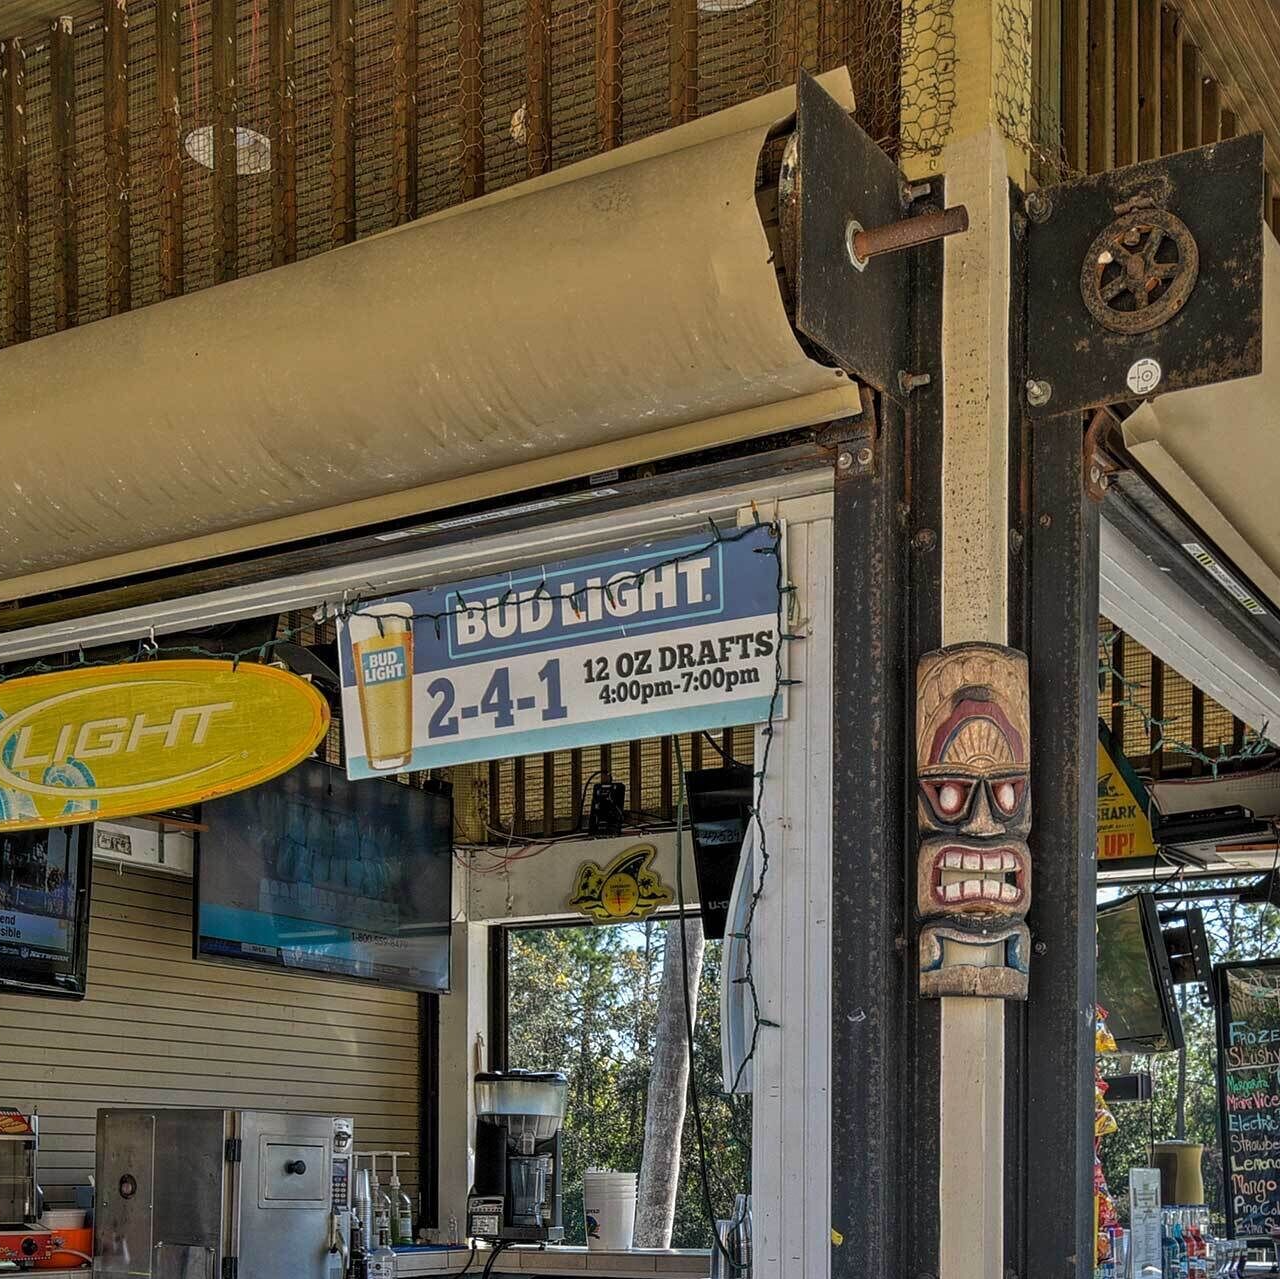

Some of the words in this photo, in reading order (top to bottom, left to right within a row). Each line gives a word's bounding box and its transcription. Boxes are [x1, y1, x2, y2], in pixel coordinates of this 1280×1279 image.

[457, 581, 553, 646] BUD
[560, 557, 711, 626] LIGHT
[365, 663, 403, 682] LIGHT
[369, 651, 397, 668] BUD
[583, 656, 609, 683] 12
[616, 649, 652, 678] OZ
[658, 630, 774, 672] DRAFTS
[427, 658, 568, 739] 2-4-1
[599, 667, 760, 704] 4:00pm-7:00pm
[9, 701, 233, 767] LIGHT
[1104, 832, 1135, 857] UP!
[1253, 1091, 1280, 1109] Vice
[1231, 1174, 1277, 1203] Mango
